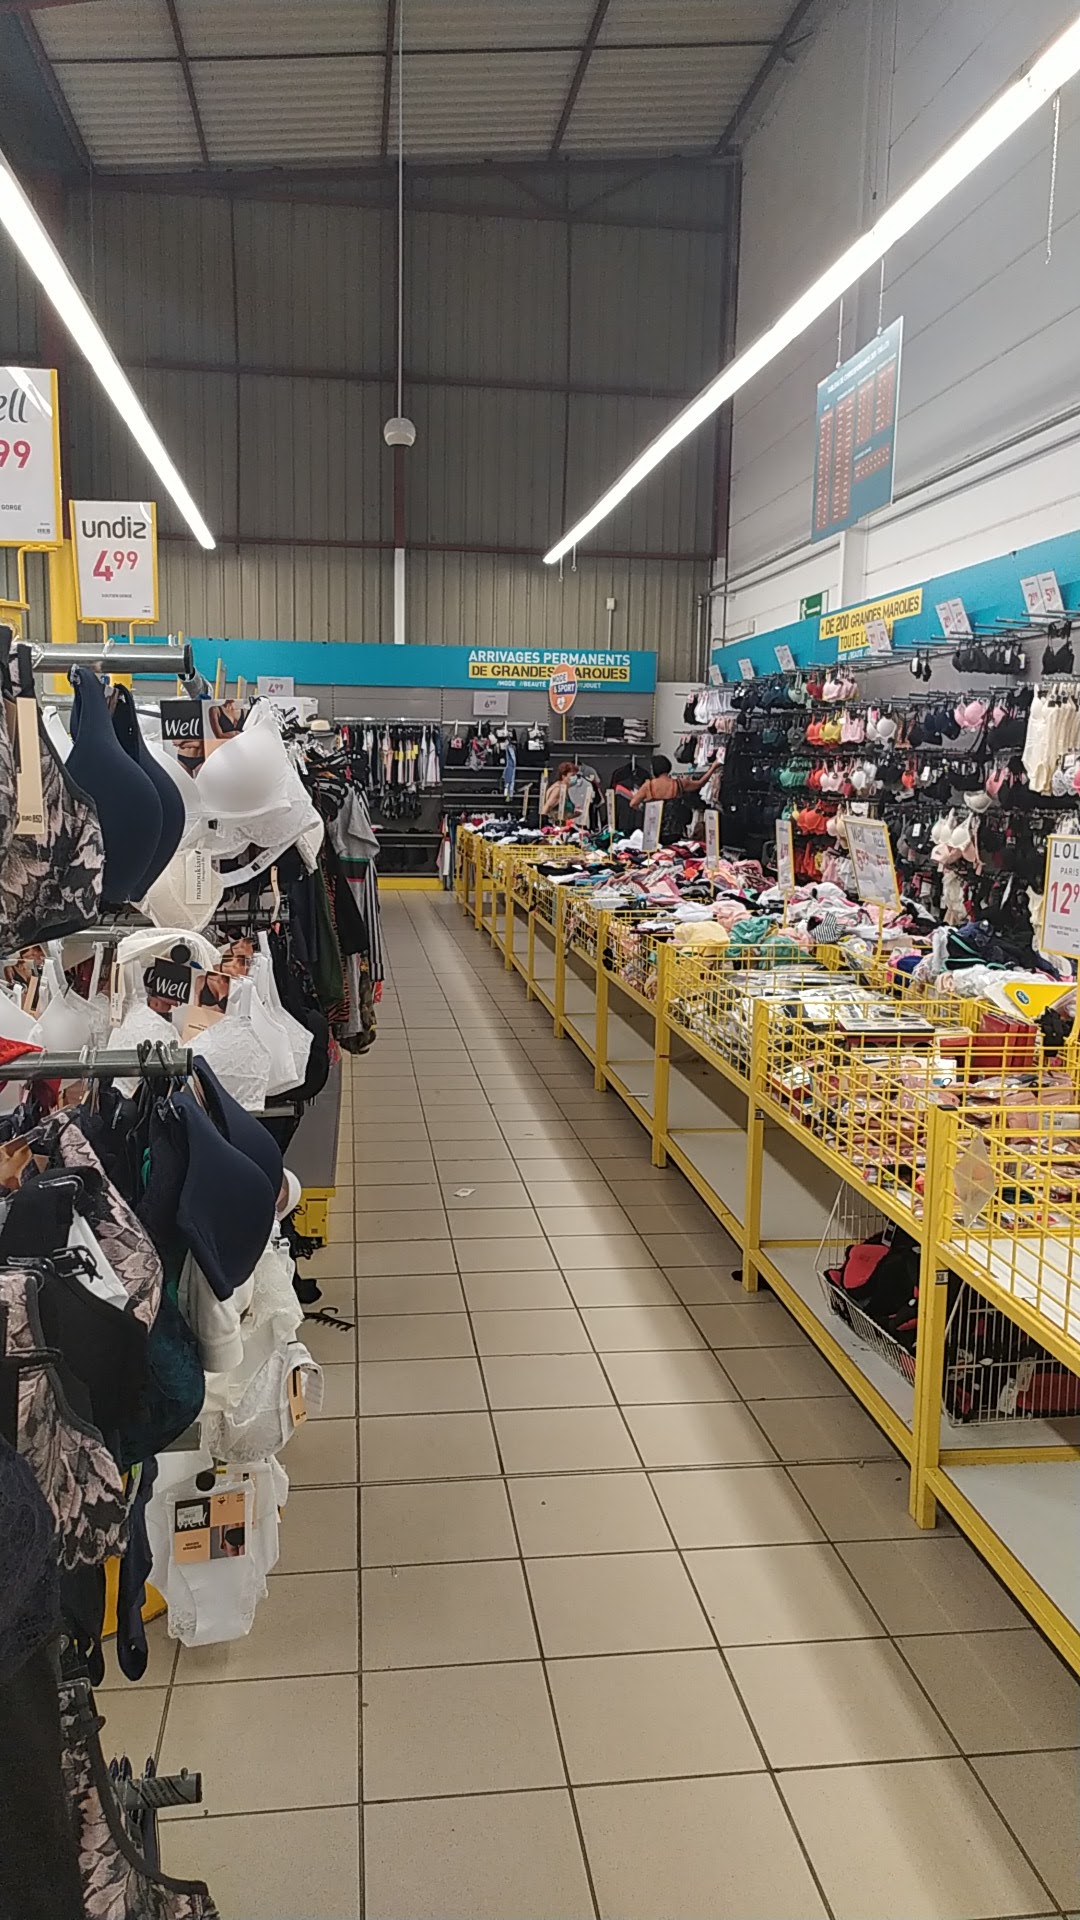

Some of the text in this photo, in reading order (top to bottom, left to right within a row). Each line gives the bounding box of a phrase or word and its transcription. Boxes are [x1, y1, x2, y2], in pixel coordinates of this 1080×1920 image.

[82, 516, 147, 539] undiz
[825, 619, 835, 636] DE
[836, 615, 849, 633] 200
[850, 608, 882, 627] GRANDES
[882, 595, 920, 619] MARQUES
[840, 633, 860, 649] TOUTE
[469, 650, 631, 666] ARRIVAGES PERMANENTS
[471, 665, 628, 680] DE GRANDES ARQUES
[552, 673, 567, 683] MODE
[268, 683, 284, 693] 499
[557, 683, 575, 693] SPORT
[165, 718, 200, 737] Well
[194, 855, 203, 900] manoukian
[1060, 867, 1080, 876] PARIS
[156, 978, 188, 1000] Well
